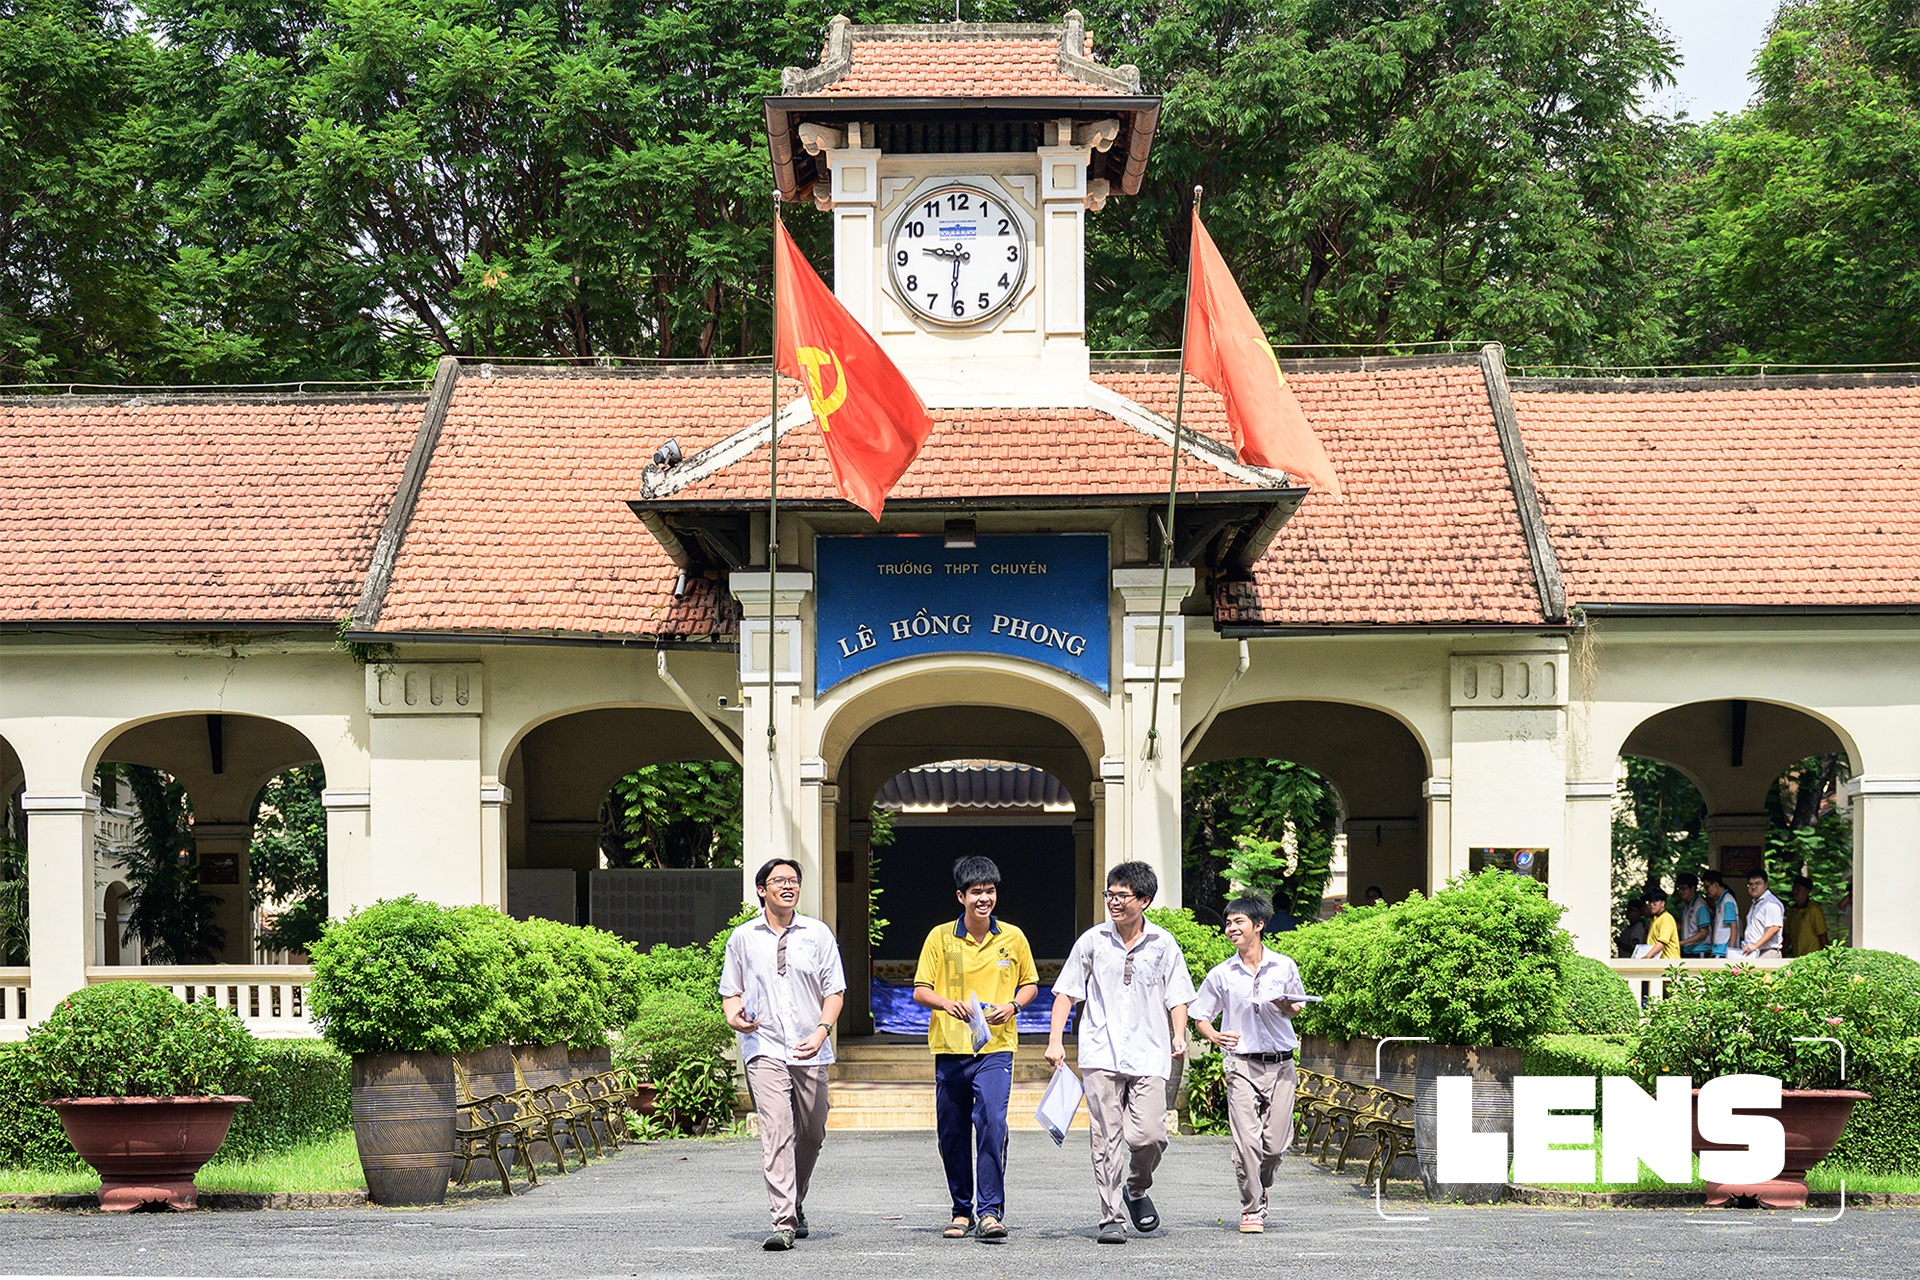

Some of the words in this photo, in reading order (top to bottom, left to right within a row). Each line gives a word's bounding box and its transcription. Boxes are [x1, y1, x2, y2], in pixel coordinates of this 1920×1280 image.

[923, 200, 940, 218] 11
[947, 194, 969, 211] 12
[979, 201, 988, 218] 1
[904, 221, 924, 239] 10
[997, 219, 1010, 236] 2
[897, 250, 909, 267] 9
[1006, 245, 1018, 262] 3
[906, 274, 918, 292] 8
[997, 272, 1010, 290] 4
[926, 293, 939, 310] 7
[953, 300, 965, 317] 6
[977, 292, 990, 310] 5
[877, 560, 933, 575] TRƯỜNG
[944, 564, 979, 574] THPT
[991, 560, 1047, 575] CHUYÊN
[837, 624, 877, 658] LÊ
[889, 607, 972, 641] HỒNG
[990, 614, 1087, 657] PHONG
